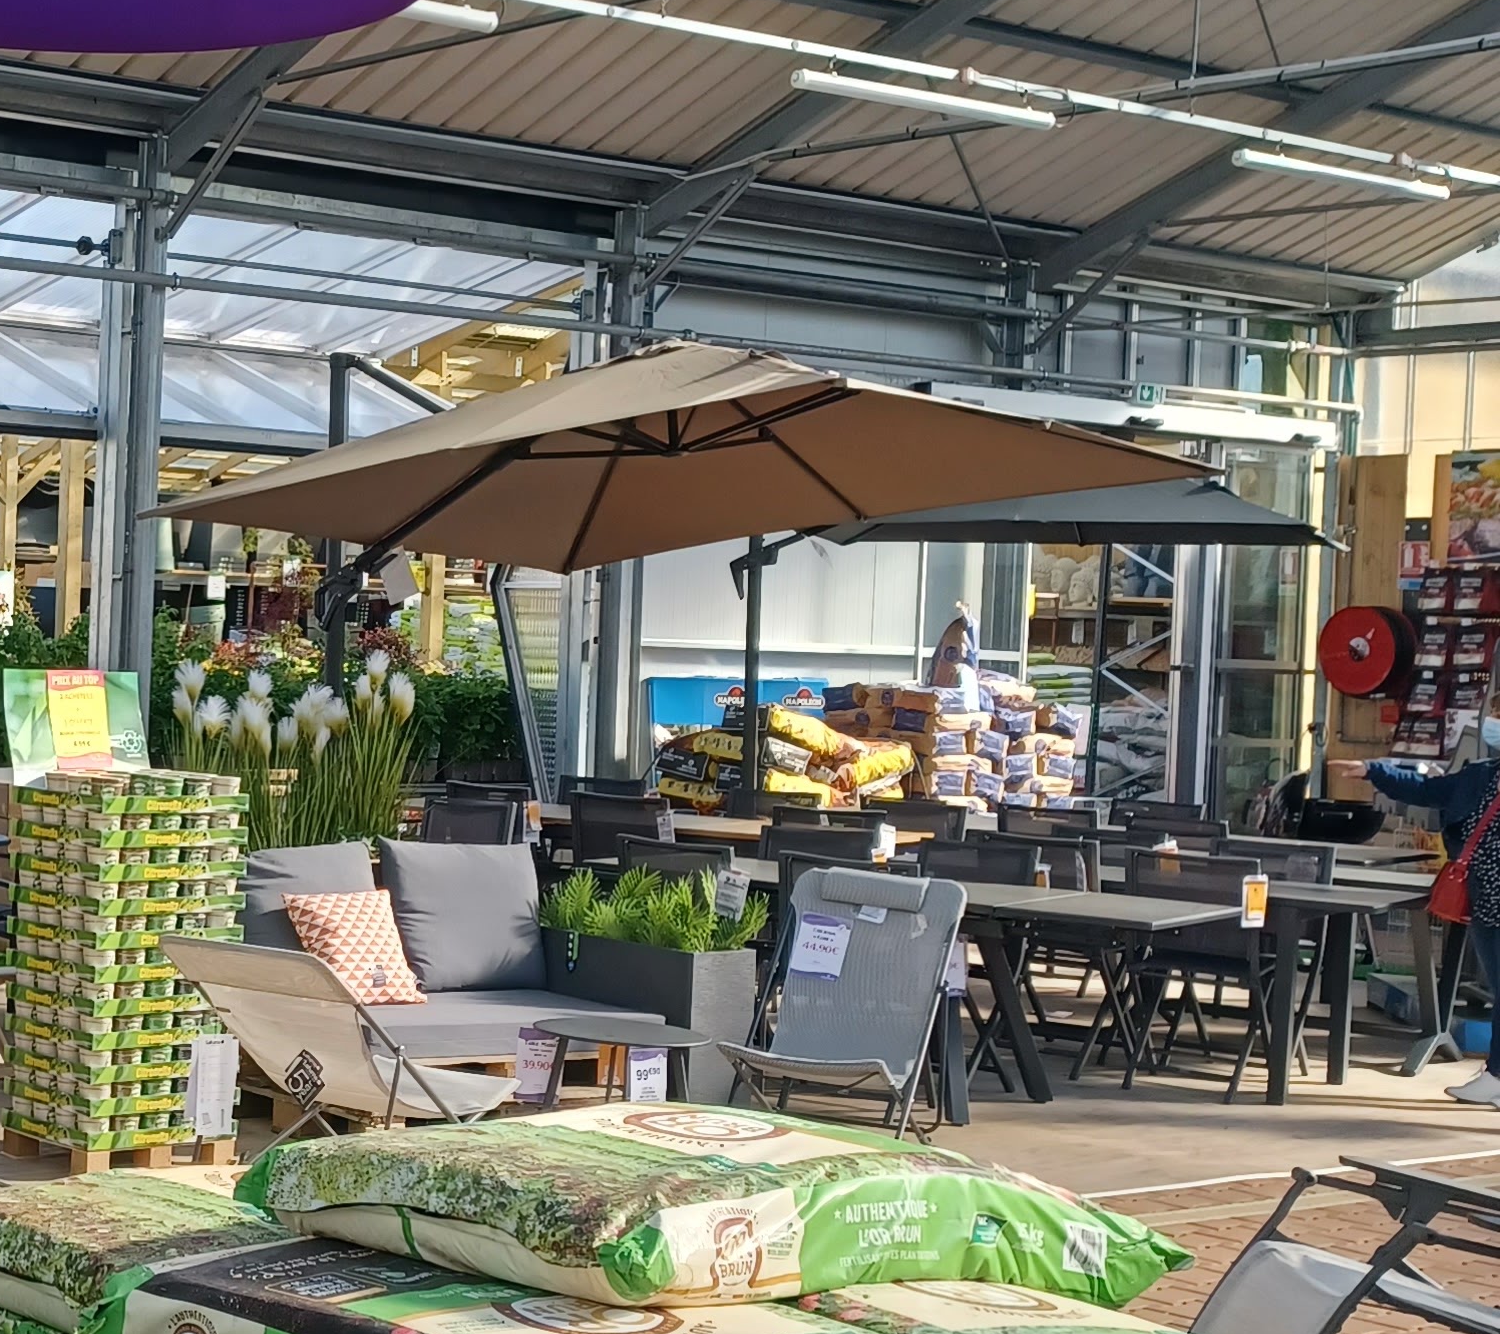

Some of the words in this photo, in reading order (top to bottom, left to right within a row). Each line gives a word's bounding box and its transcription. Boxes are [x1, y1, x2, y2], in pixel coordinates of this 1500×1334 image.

[51, 675, 71, 685] PRIX
[72, 675, 83, 685] AU
[84, 675, 100, 685] TOP
[802, 941, 840, 956] 44.90€
[845, 1200, 928, 1224] AUTHENTIQUE
[719, 1260, 753, 1278] BRUN
